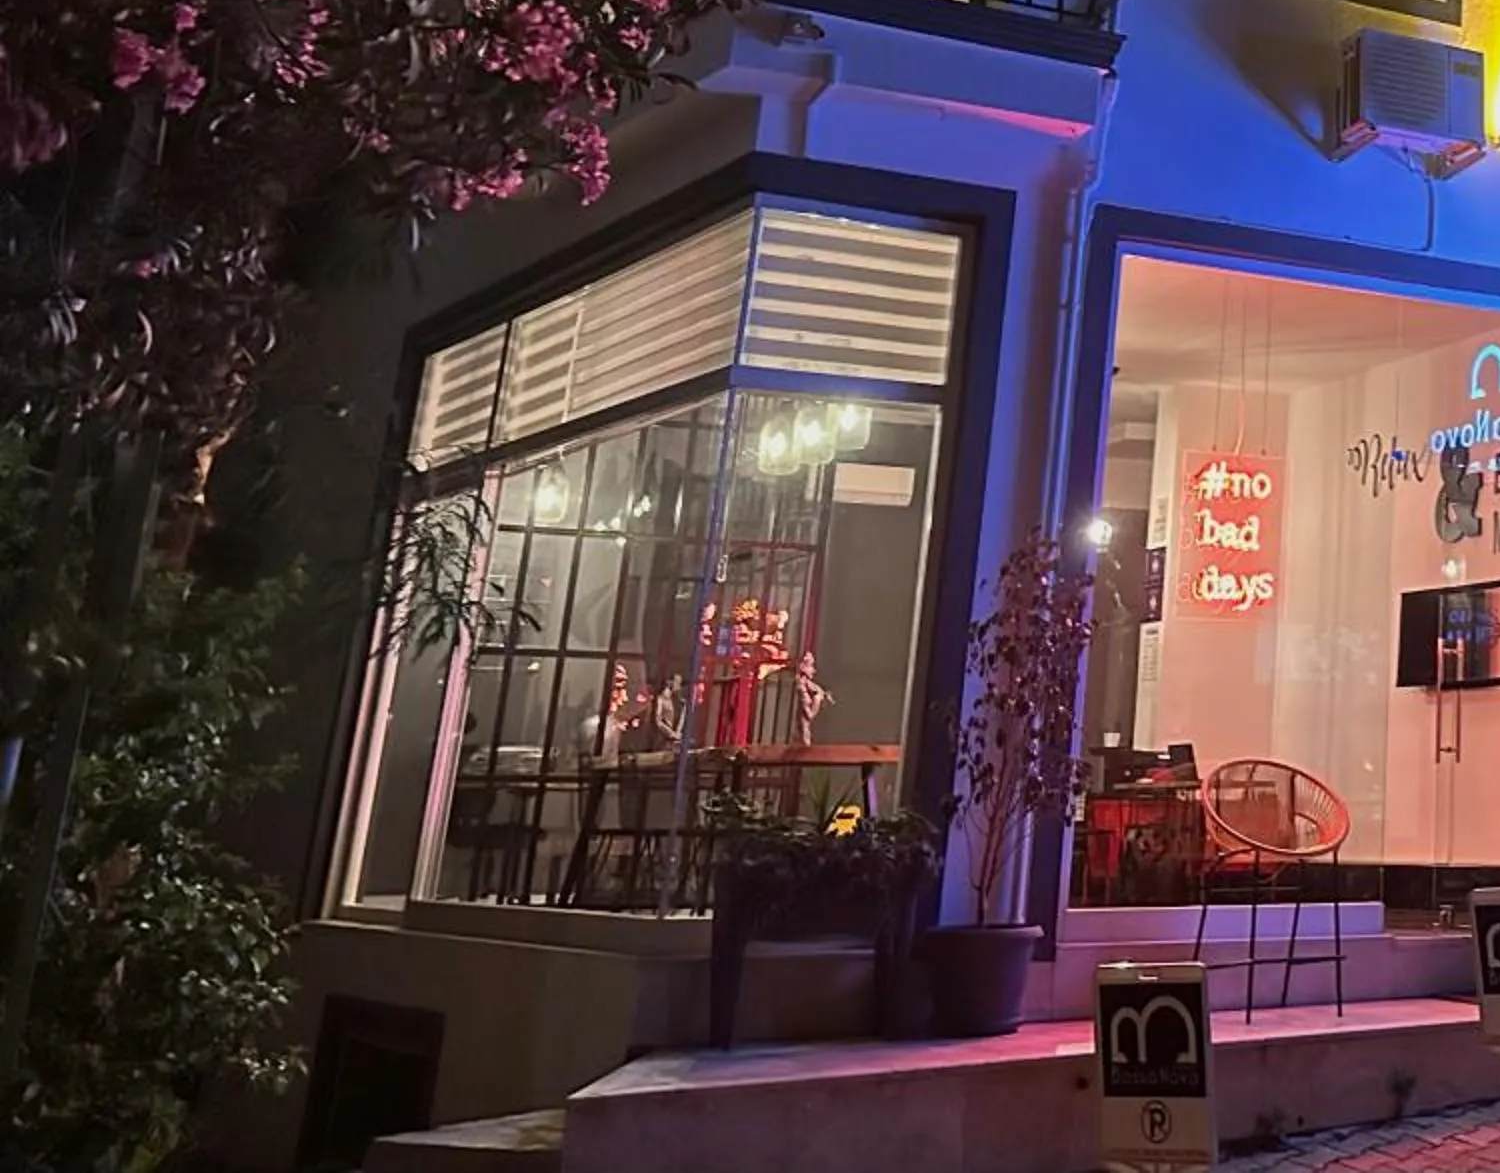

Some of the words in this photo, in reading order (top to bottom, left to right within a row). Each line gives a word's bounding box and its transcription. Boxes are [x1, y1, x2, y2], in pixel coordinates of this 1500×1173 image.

[1198, 460, 1273, 500] #no
[1196, 508, 1261, 552] bad
[1199, 564, 1274, 612] days
